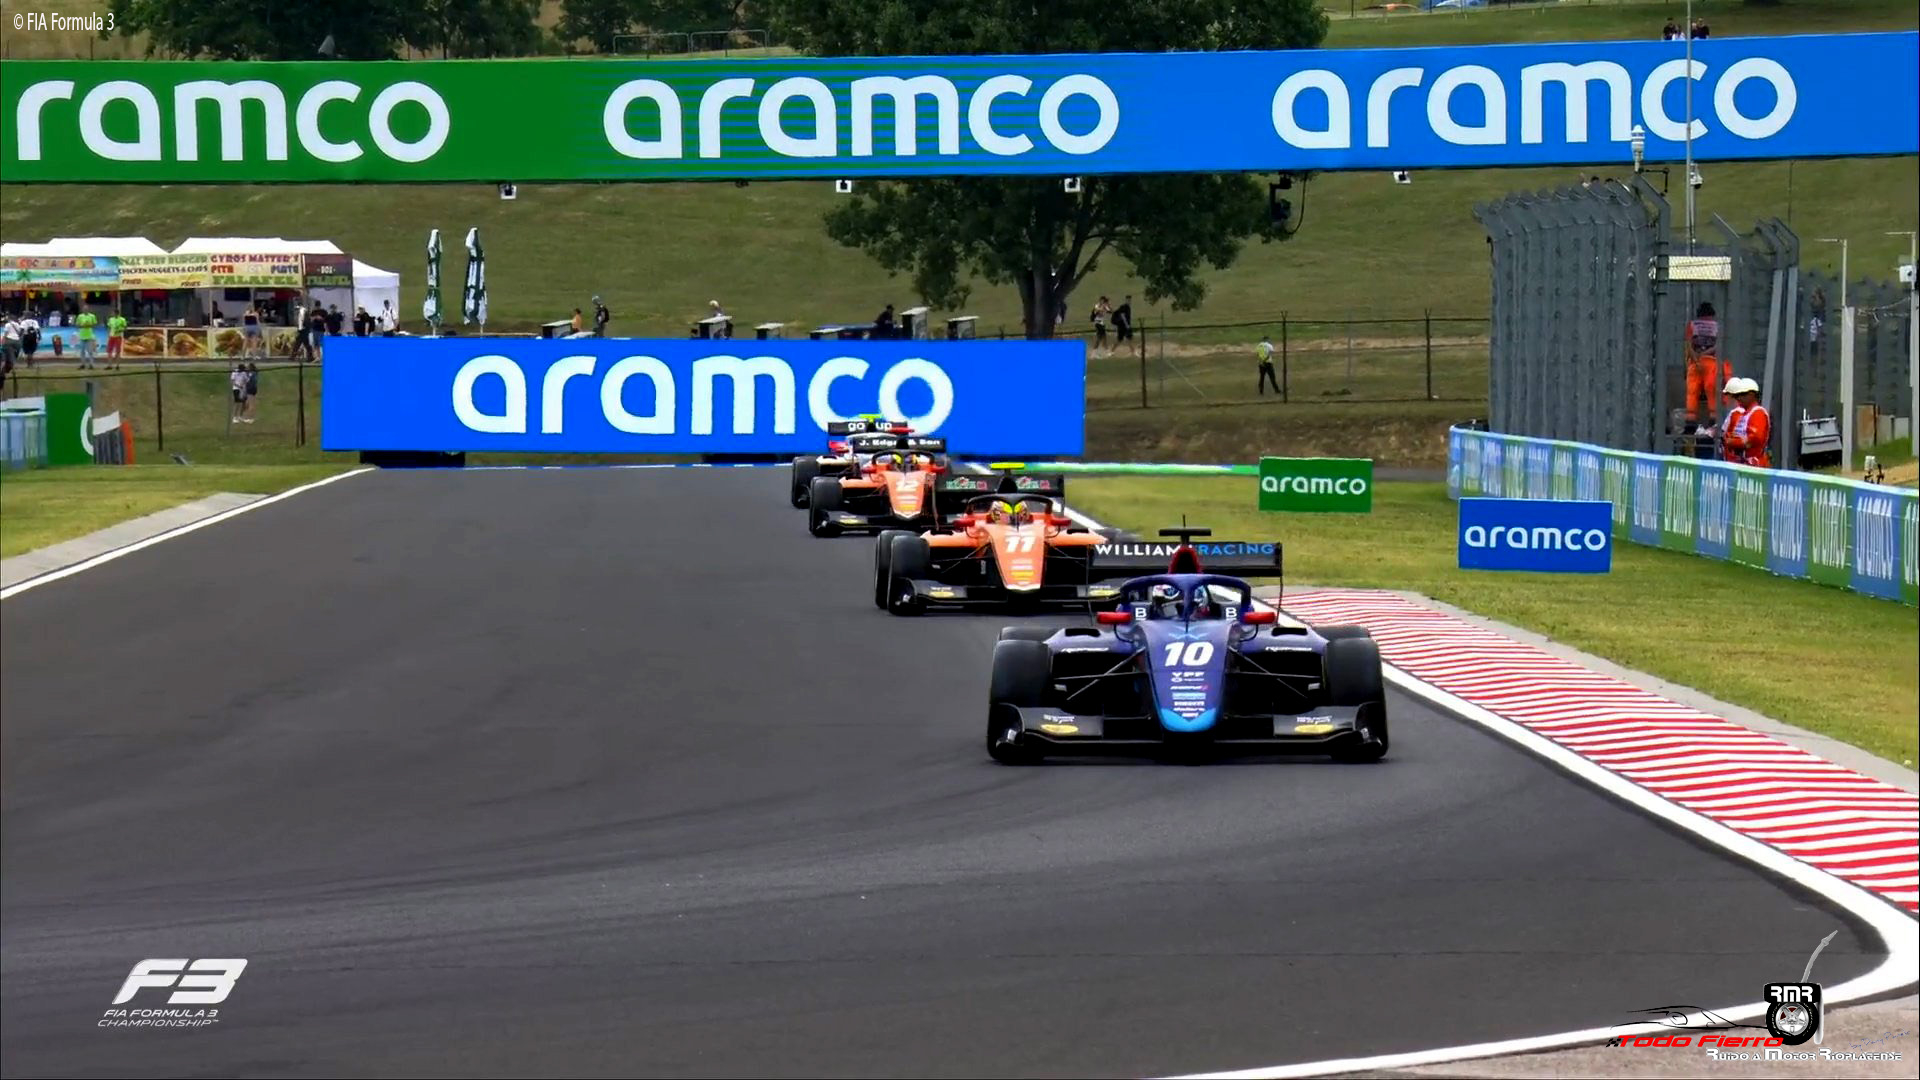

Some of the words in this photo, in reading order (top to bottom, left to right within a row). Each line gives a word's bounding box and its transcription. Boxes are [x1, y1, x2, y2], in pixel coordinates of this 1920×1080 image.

[1272, 57, 1797, 148] aramco
[603, 74, 1120, 159] aramco
[211, 254, 246, 262] GYROS
[187, 265, 208, 273] CHIPS
[211, 265, 234, 273] PITA
[212, 276, 298, 285] FALAFEL
[452, 355, 954, 436] aramco
[847, 421, 866, 432] go
[875, 419, 893, 431] up
[895, 480, 919, 492] 12
[1261, 476, 1367, 496] aramco
[1004, 536, 1036, 553] 11
[1464, 525, 1606, 551] aramco
[1095, 542, 1184, 556] WILLIAM
[1196, 543, 1275, 556] RACING
[1164, 641, 1214, 667] 10
